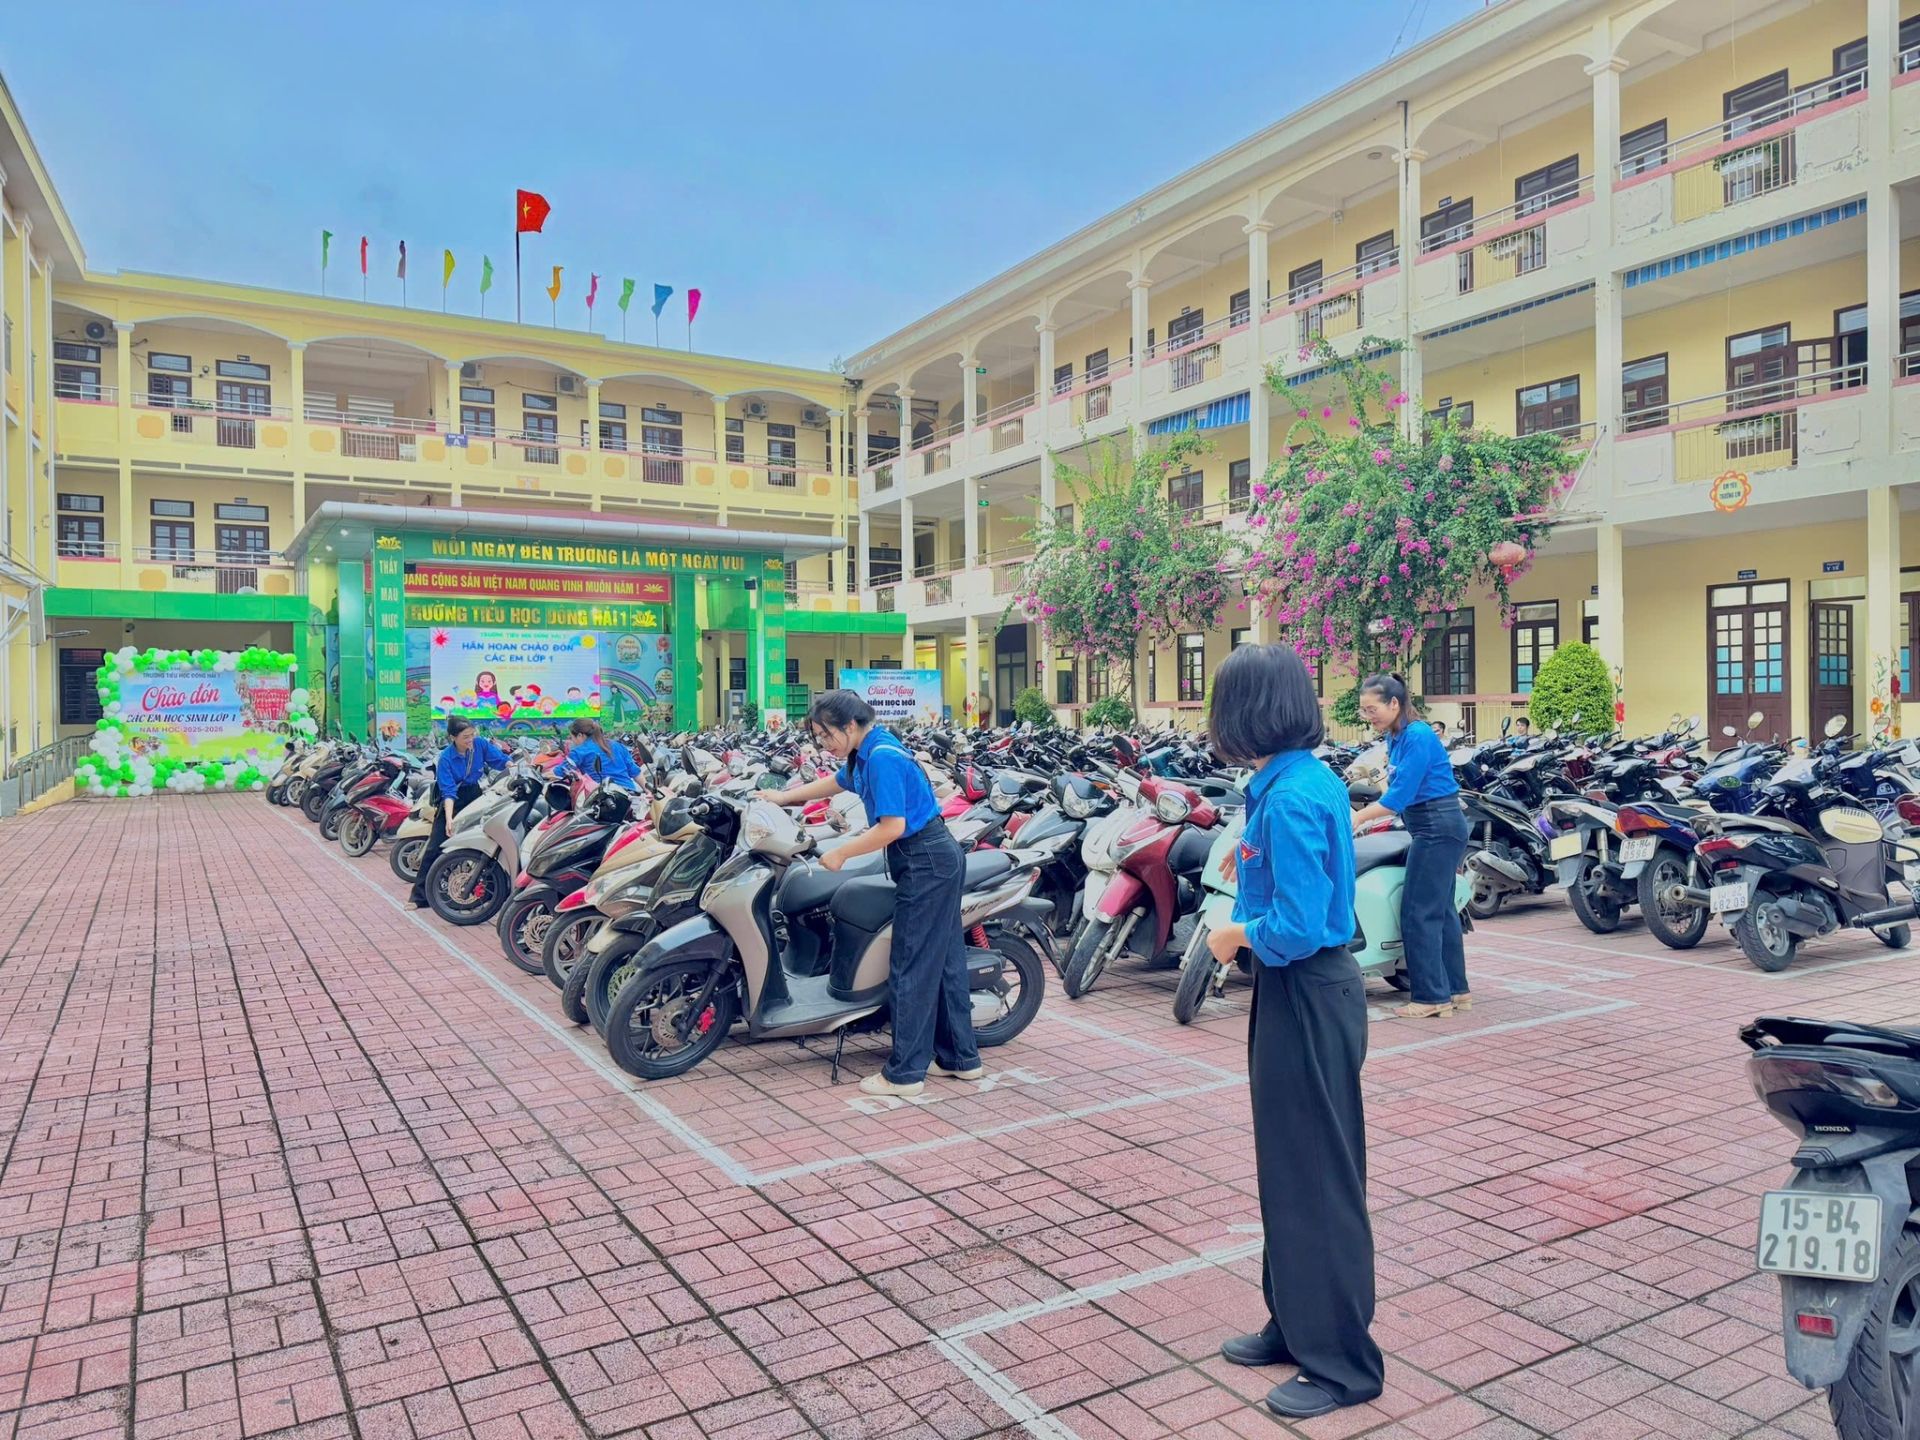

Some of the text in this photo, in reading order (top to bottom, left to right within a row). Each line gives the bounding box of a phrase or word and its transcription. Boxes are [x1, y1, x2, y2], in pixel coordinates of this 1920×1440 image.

[556, 543, 617, 565] TRƯỜNG
[622, 547, 641, 566] LÀ
[645, 549, 677, 570] MỘT
[682, 551, 720, 570] NGÀY
[722, 556, 745, 571] VUI
[431, 571, 458, 589] CỘNG
[460, 571, 481, 588] SẢN
[483, 574, 503, 591] VIỆT
[505, 577, 527, 590] NAM
[529, 578, 560, 592] QUANG
[562, 579, 583, 592] VINH
[585, 579, 611, 593] MUÔN
[613, 580, 634, 594] NĂM
[471, 599, 505, 623] TIỂU
[510, 606, 541, 627] HỌC
[620, 611, 627, 626] 1
[488, 642, 517, 651] HOAN
[509, 654, 523, 662] EM
[527, 653, 546, 663] LỚP
[141, 681, 220, 712] Chào đón
[126, 711, 146, 723] CÁC
[147, 713, 163, 723] EM
[164, 713, 185, 723] HỌC
[185, 712, 209, 723] SINH
[210, 711, 229, 723] LỚP
[1814, 1125, 1852, 1133] HONDA
[1780, 1197, 1860, 1235] 15-B4
[1763, 1233, 1871, 1275] 219.18
